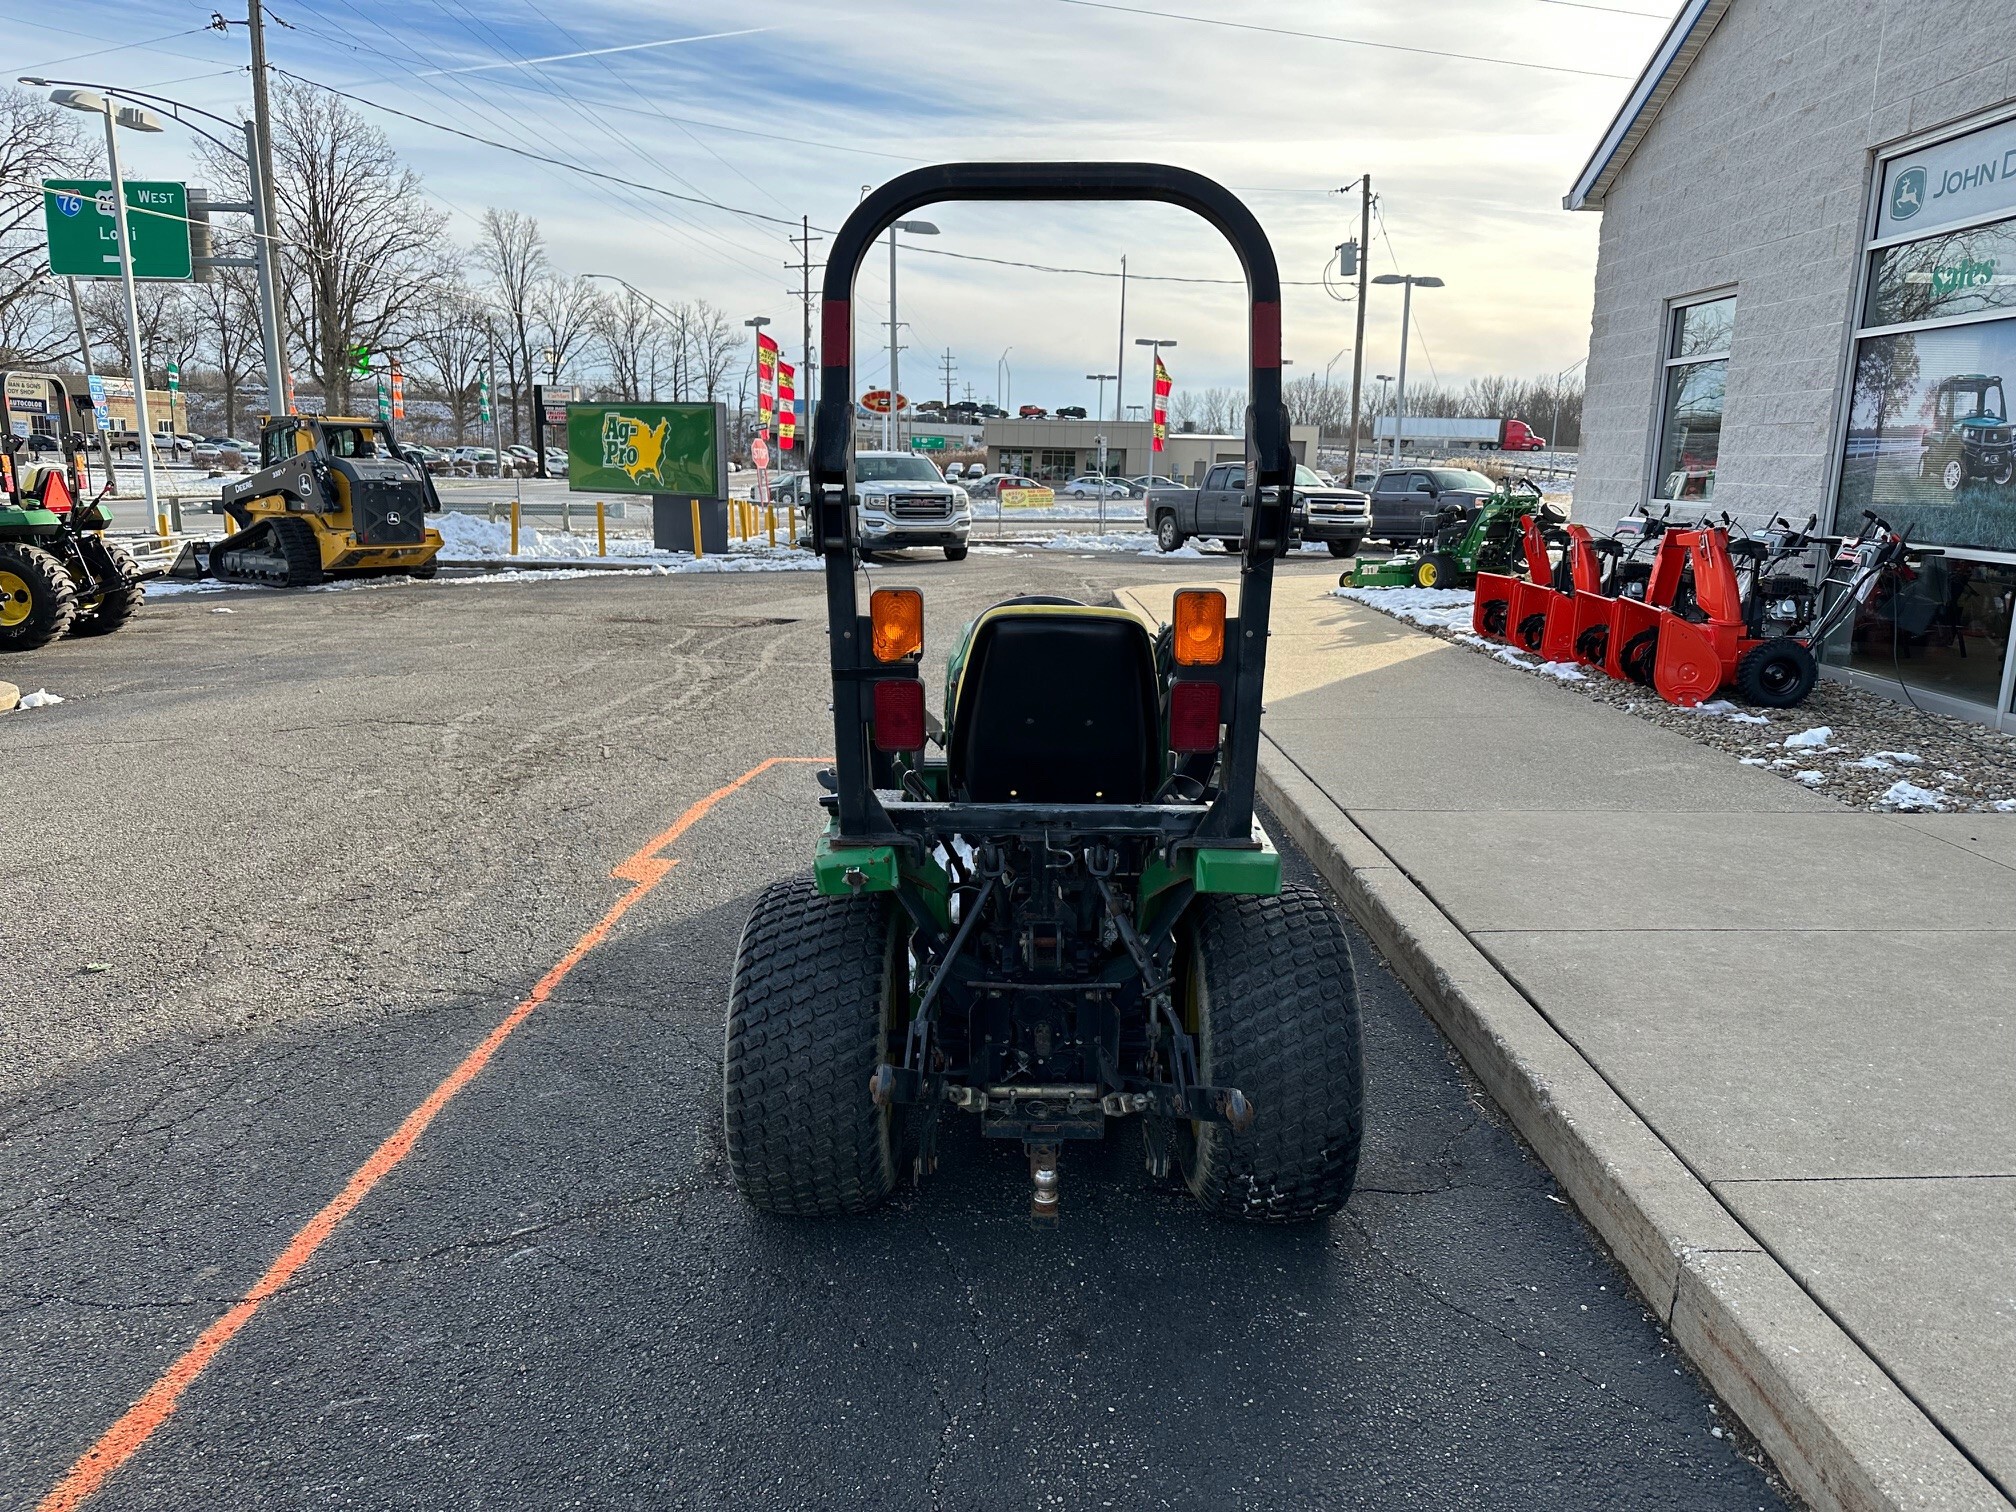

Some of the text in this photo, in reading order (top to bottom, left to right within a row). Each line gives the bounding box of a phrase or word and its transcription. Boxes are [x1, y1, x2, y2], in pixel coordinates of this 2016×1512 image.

[1933, 160, 1997, 198] JOHN
[59, 195, 80, 212] 76
[99, 195, 115, 211] 22
[138, 189, 174, 204] WEST
[99, 226, 136, 240] Loi
[10, 399, 42, 408] AUTOCOLOR
[97, 407, 107, 415] 76
[604, 415, 638, 448] Ag-
[604, 440, 638, 466] Pro
[753, 447, 767, 459] STOP
[235, 480, 254, 493] DEERE
[909, 498, 936, 507] GMC
